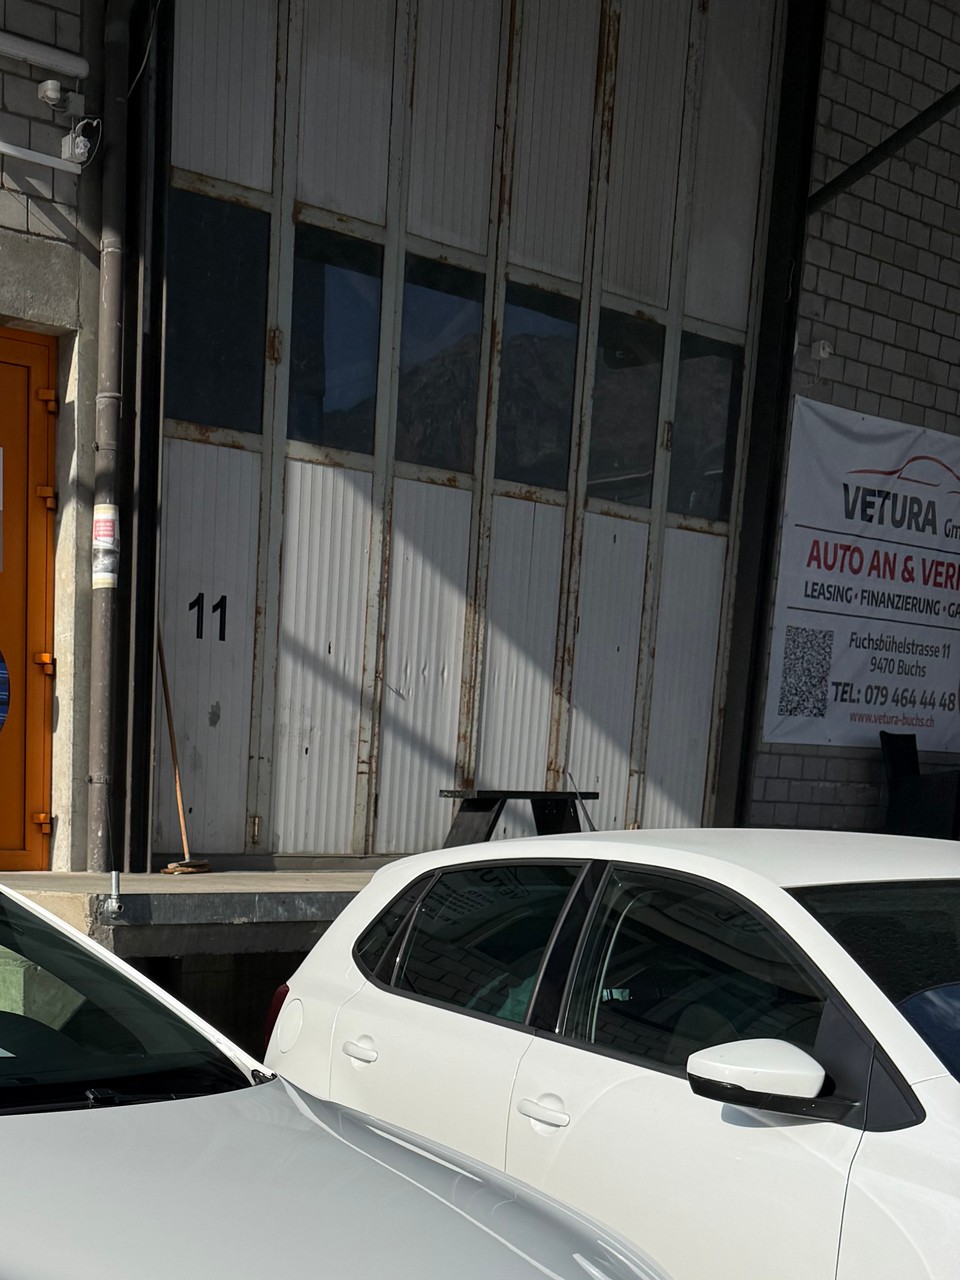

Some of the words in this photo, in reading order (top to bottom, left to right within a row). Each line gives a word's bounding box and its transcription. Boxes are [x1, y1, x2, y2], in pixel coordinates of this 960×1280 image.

[843, 483, 937, 535] VETURA
[806, 538, 864, 575] AUTO
[867, 549, 897, 581] AN
[901, 555, 915, 583] &
[804, 580, 853, 604] LEASING
[860, 589, 940, 616] FINANZIERUNG
[189, 592, 227, 641] 11
[849, 631, 940, 658] Fuchsbühelstrasse
[942, 643, 951, 659] 11
[869, 656, 895, 674] 9470
[897, 659, 927, 677] Buchs
[831, 681, 861, 703] TEL:
[864, 684, 889, 705] 079
[891, 687, 917, 708] 464
[919, 689, 936, 710] 44
[938, 691, 956, 711] 48
[849, 712, 935, 728] www.vetura-buchs.ch
